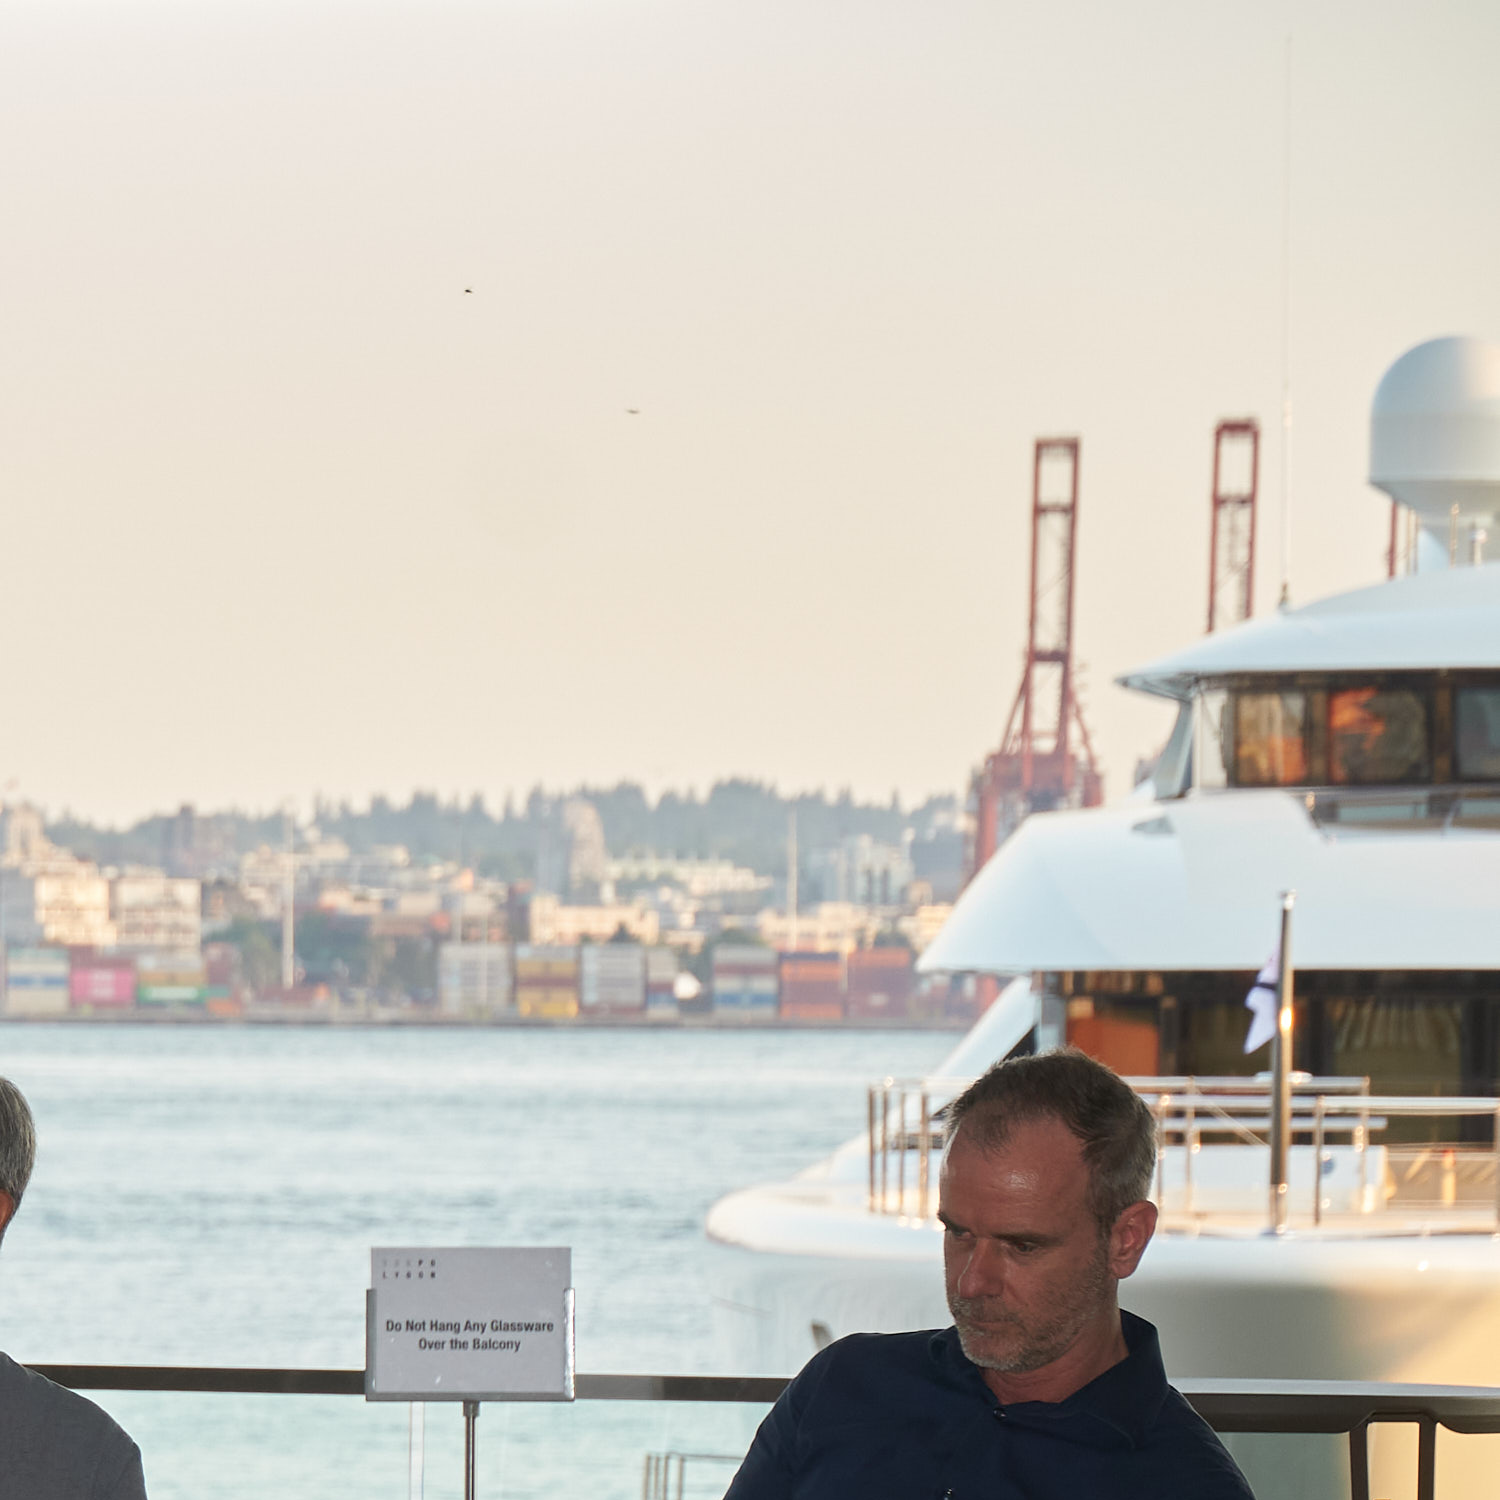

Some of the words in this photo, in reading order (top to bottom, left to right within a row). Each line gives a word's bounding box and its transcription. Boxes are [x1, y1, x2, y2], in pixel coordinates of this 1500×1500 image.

[386, 1320, 402, 1332] Do
[406, 1320, 426, 1332] Not
[430, 1320, 461, 1335] Hang
[464, 1320, 487, 1335] Any
[491, 1320, 554, 1332] Glassware
[418, 1338, 446, 1350] Over
[450, 1338, 469, 1350] the
[472, 1338, 521, 1353] Balcony
